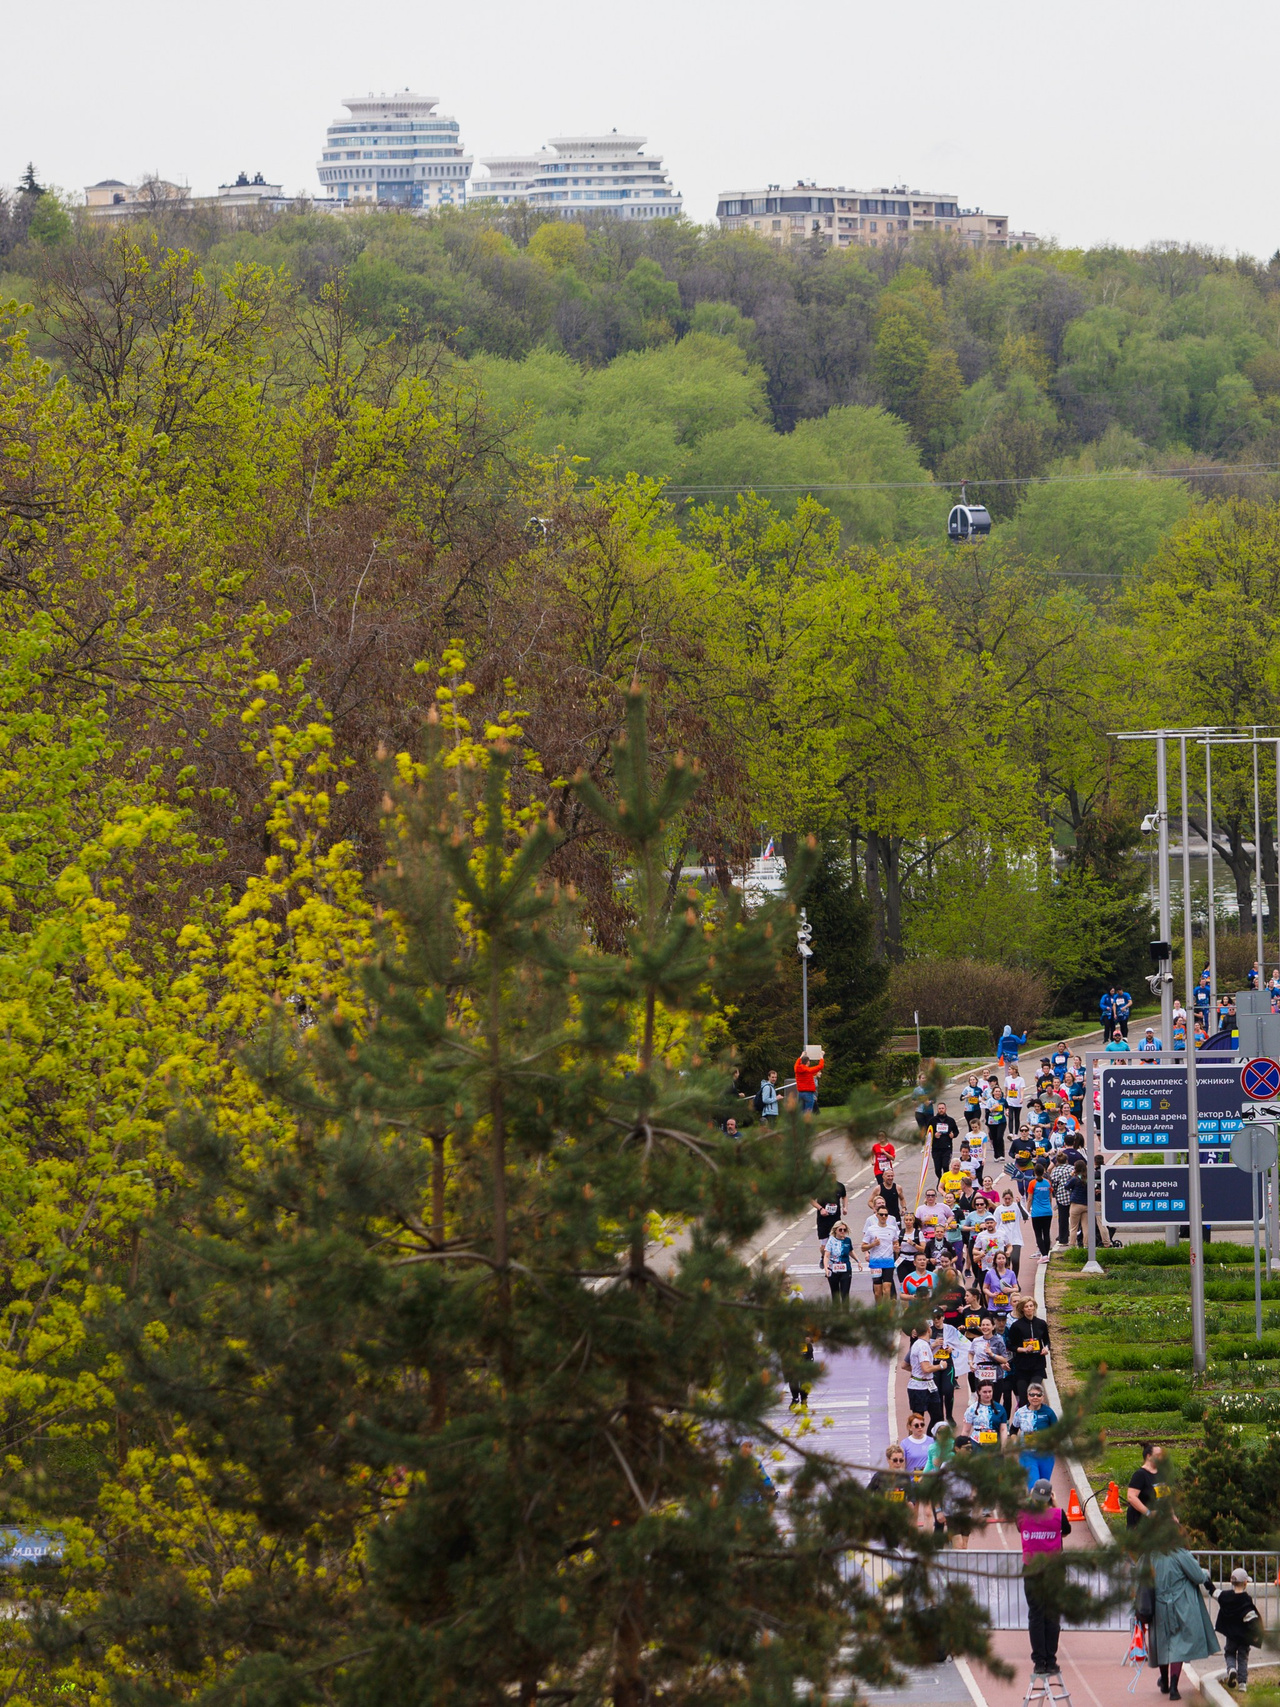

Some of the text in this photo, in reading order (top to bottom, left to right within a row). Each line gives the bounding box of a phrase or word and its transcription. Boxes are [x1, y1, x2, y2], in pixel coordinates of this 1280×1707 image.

[1184, 1078, 1235, 1087] «ужники»
[1121, 1088, 1148, 1096] Aquatic
[1121, 1113, 1187, 1122] Большая арена
[1151, 1181, 1178, 1189] арена
[1122, 1191, 1147, 1199] Malaya
